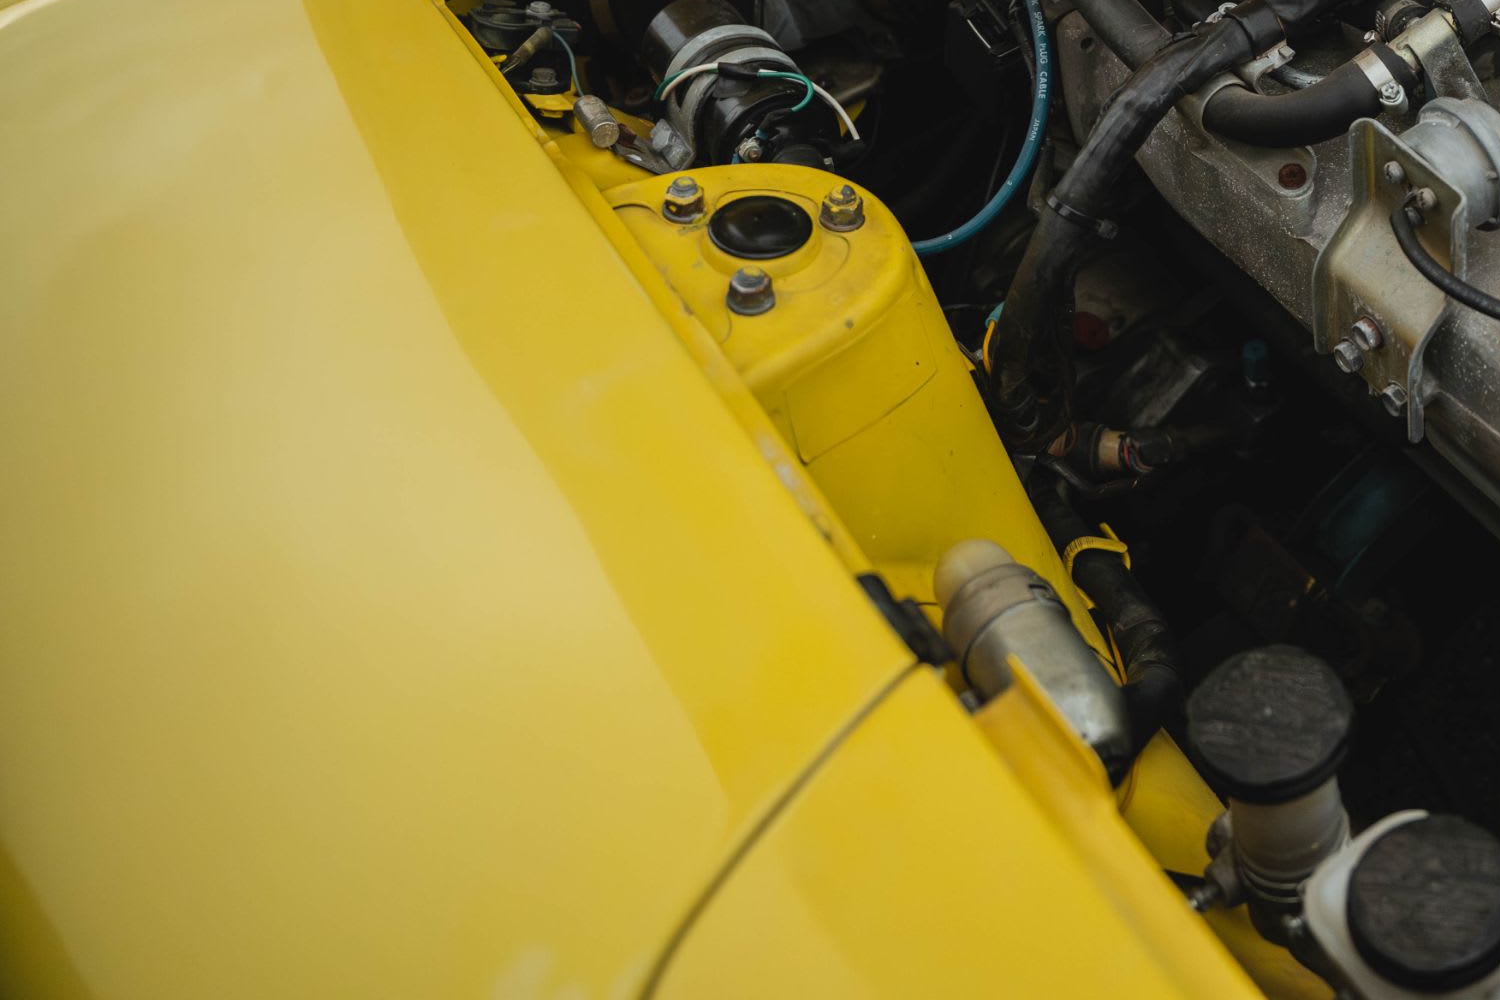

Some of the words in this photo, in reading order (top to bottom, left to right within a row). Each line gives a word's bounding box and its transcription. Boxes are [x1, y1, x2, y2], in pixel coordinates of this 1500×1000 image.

[1033, 11, 1047, 37] SPARK
[1039, 41, 1049, 65] PLUG
[1037, 70, 1048, 100] CABLE
[1029, 117, 1041, 142] JAPAN
